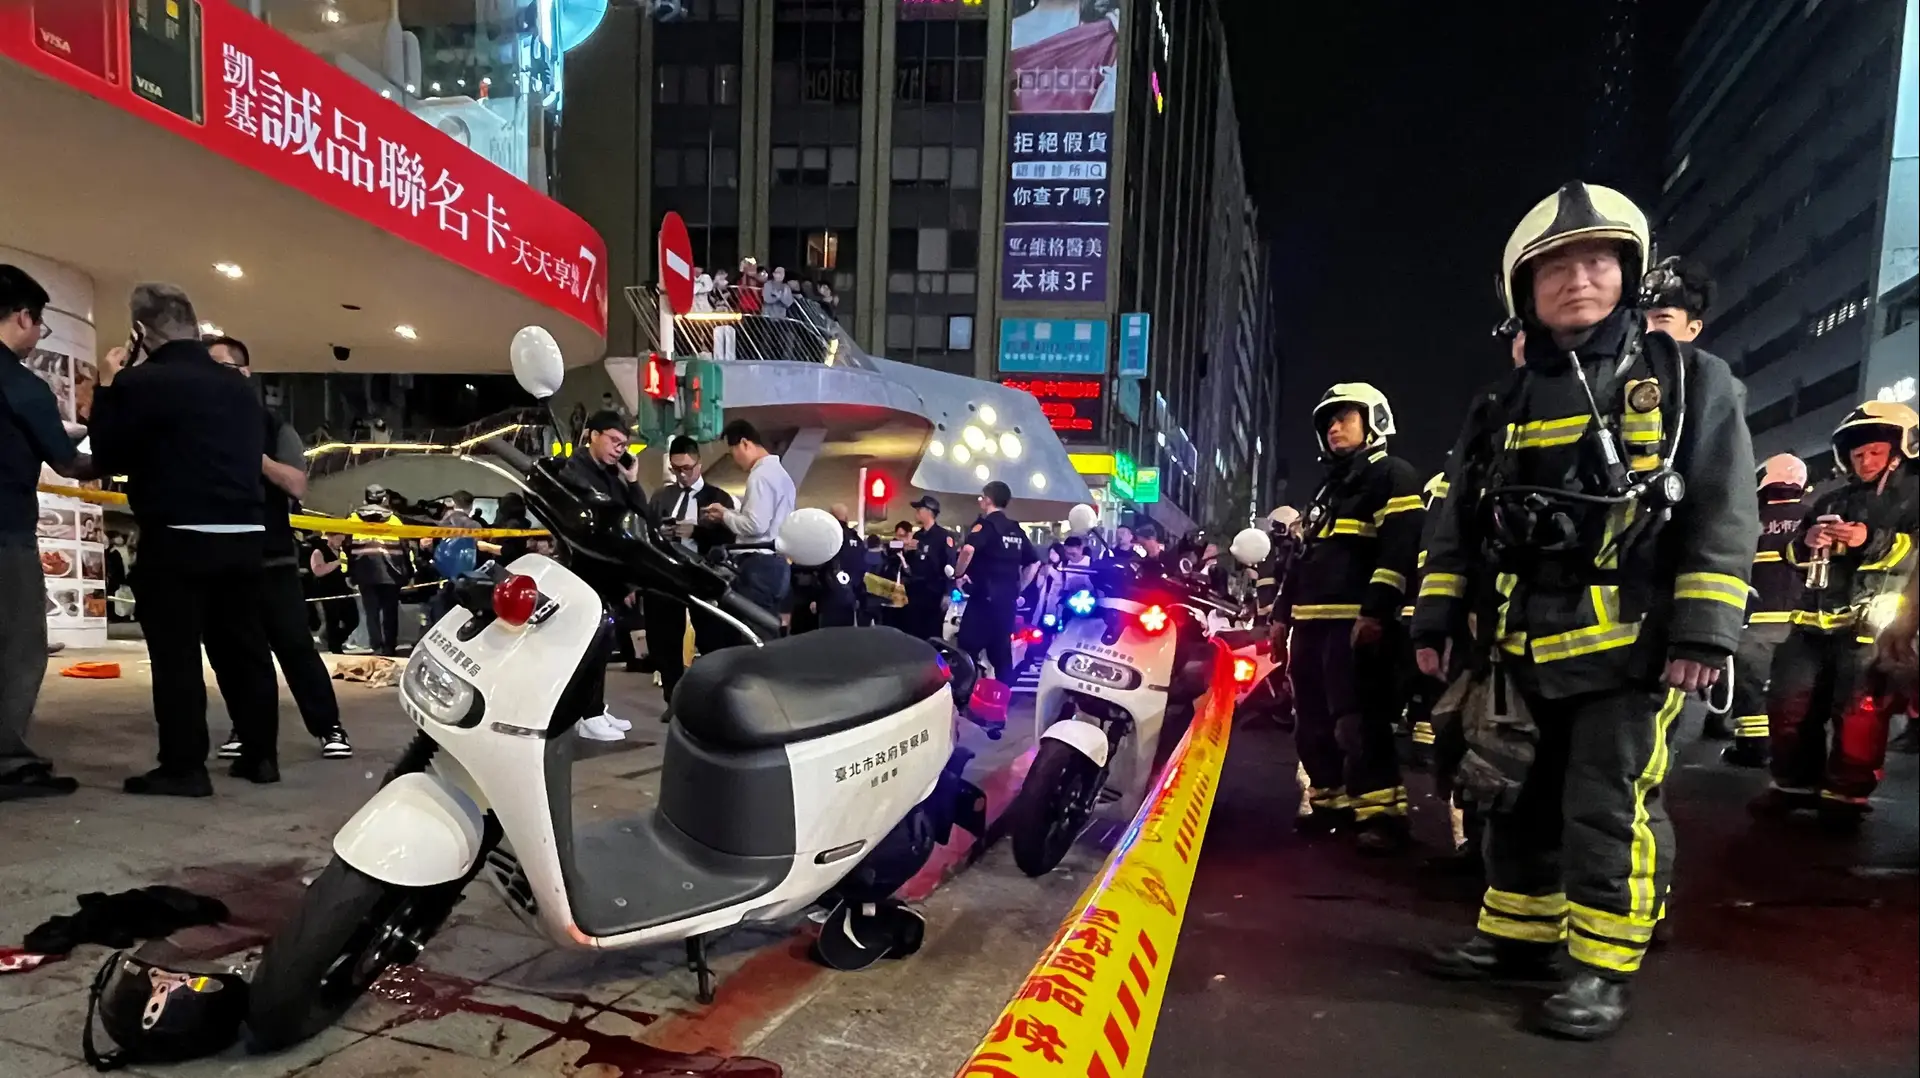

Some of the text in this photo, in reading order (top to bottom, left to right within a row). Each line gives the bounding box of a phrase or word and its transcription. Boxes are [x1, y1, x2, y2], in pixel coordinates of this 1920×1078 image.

[40, 28, 71, 53] VISA
[136, 75, 163, 98] VISA
[1013, 131, 1107, 154] 拒絕假貨
[1028, 237, 1102, 258] 維格醫美
[1012, 268, 1094, 293] 本棟3F
[834, 729, 930, 783] 臺北市政府警察局
